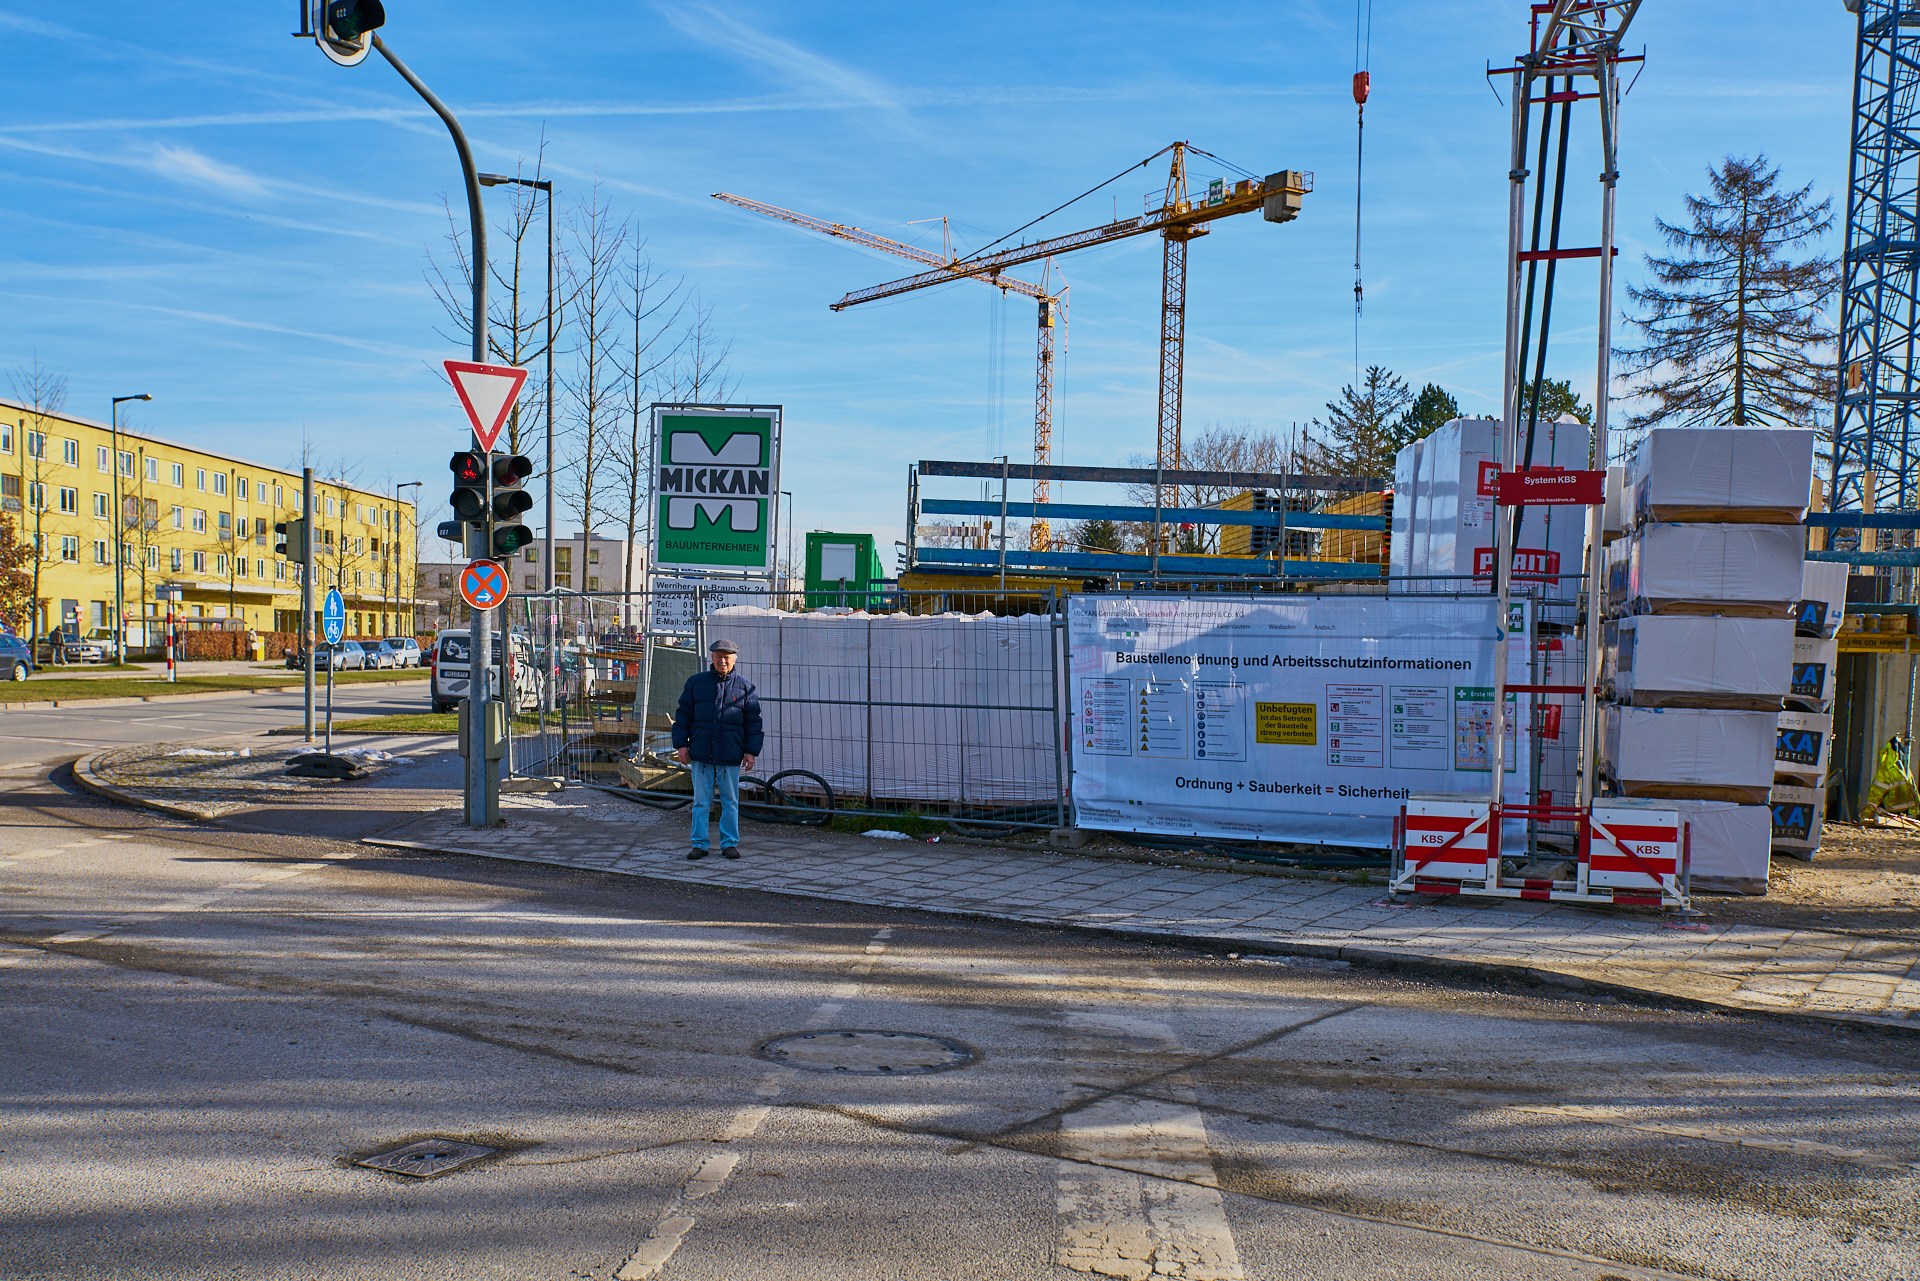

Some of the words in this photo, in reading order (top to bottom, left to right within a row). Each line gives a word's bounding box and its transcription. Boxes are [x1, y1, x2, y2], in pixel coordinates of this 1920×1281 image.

[660, 468, 770, 495] MICKAN
[1524, 475, 1557, 486] System
[1557, 475, 1577, 484] KBS
[665, 540, 760, 552] BAUUNTERNEHMEN
[1479, 553, 1550, 572] PRIT
[1174, 611, 1200, 620] Amberg
[1073, 621, 1093, 629] Amberg
[1313, 624, 1337, 632] Ansbach
[1116, 651, 1239, 669] Baustellenodnung
[1243, 655, 1269, 667] und
[1271, 655, 1473, 671] Arbeitsschutzinformationen
[1470, 690, 1486, 698] Erste
[1260, 704, 1313, 715] Unbefugten
[1277, 722, 1309, 730] Baustelle
[1786, 718, 1808, 726] 20/2.0
[1260, 729, 1282, 738] streng
[1174, 776, 1233, 794] Ordnung
[1236, 781, 1245, 791] +
[1248, 780, 1322, 796] Sauberkeit
[1337, 784, 1411, 801] Sicherheit
[1420, 833, 1444, 845] KBS
[1636, 844, 1660, 855] KBS
